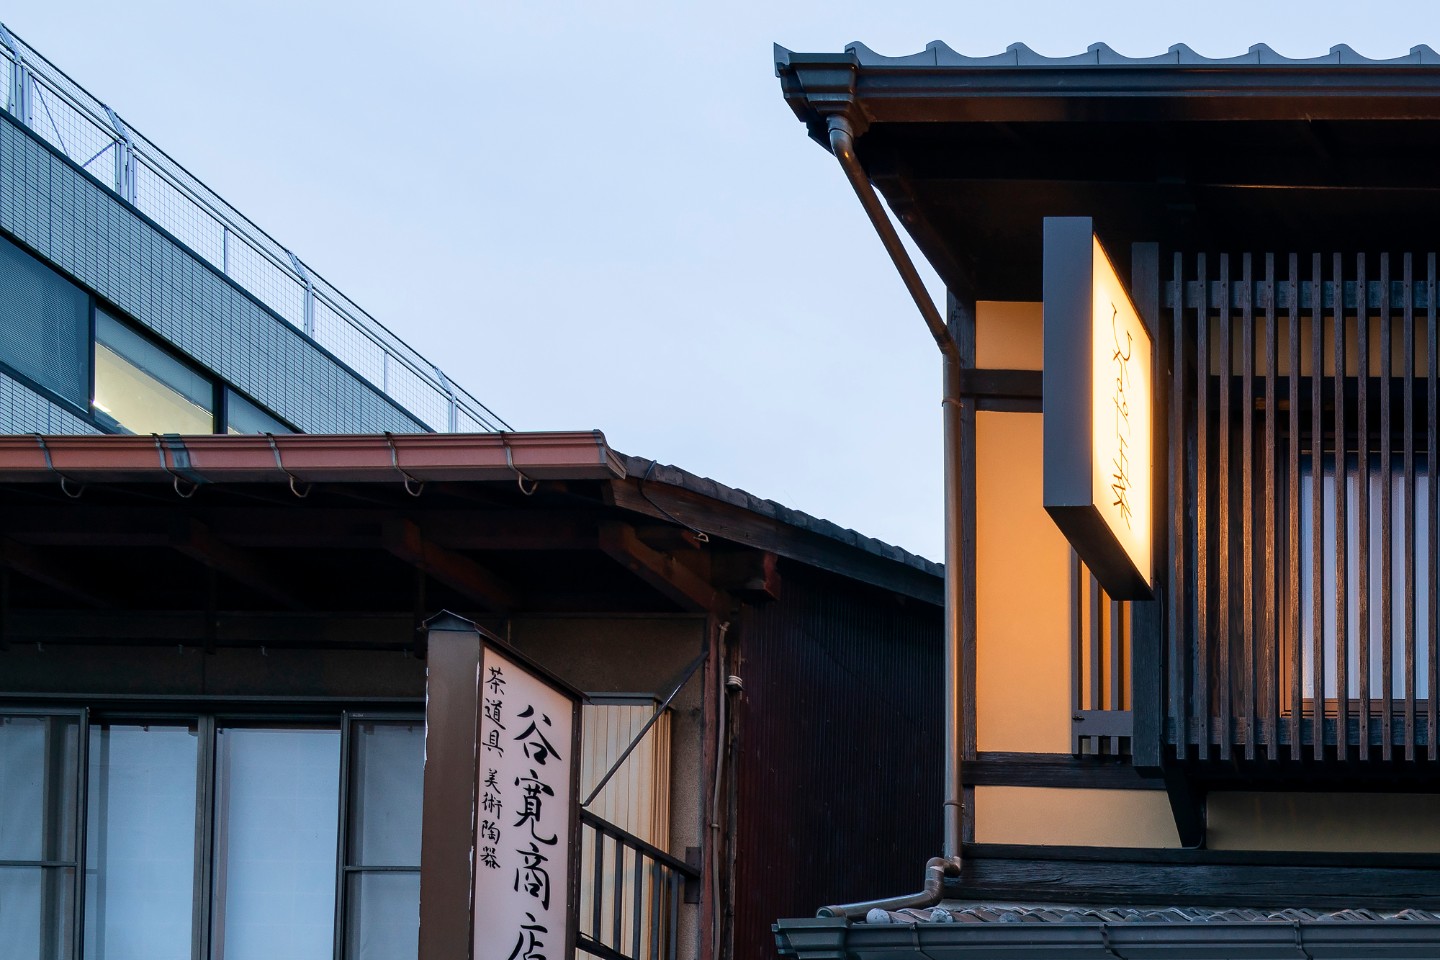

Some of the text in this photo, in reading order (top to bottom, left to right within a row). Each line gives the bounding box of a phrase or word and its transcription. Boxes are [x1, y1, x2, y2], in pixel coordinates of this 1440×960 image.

[480, 666, 507, 870] 茶道具 美術陶器
